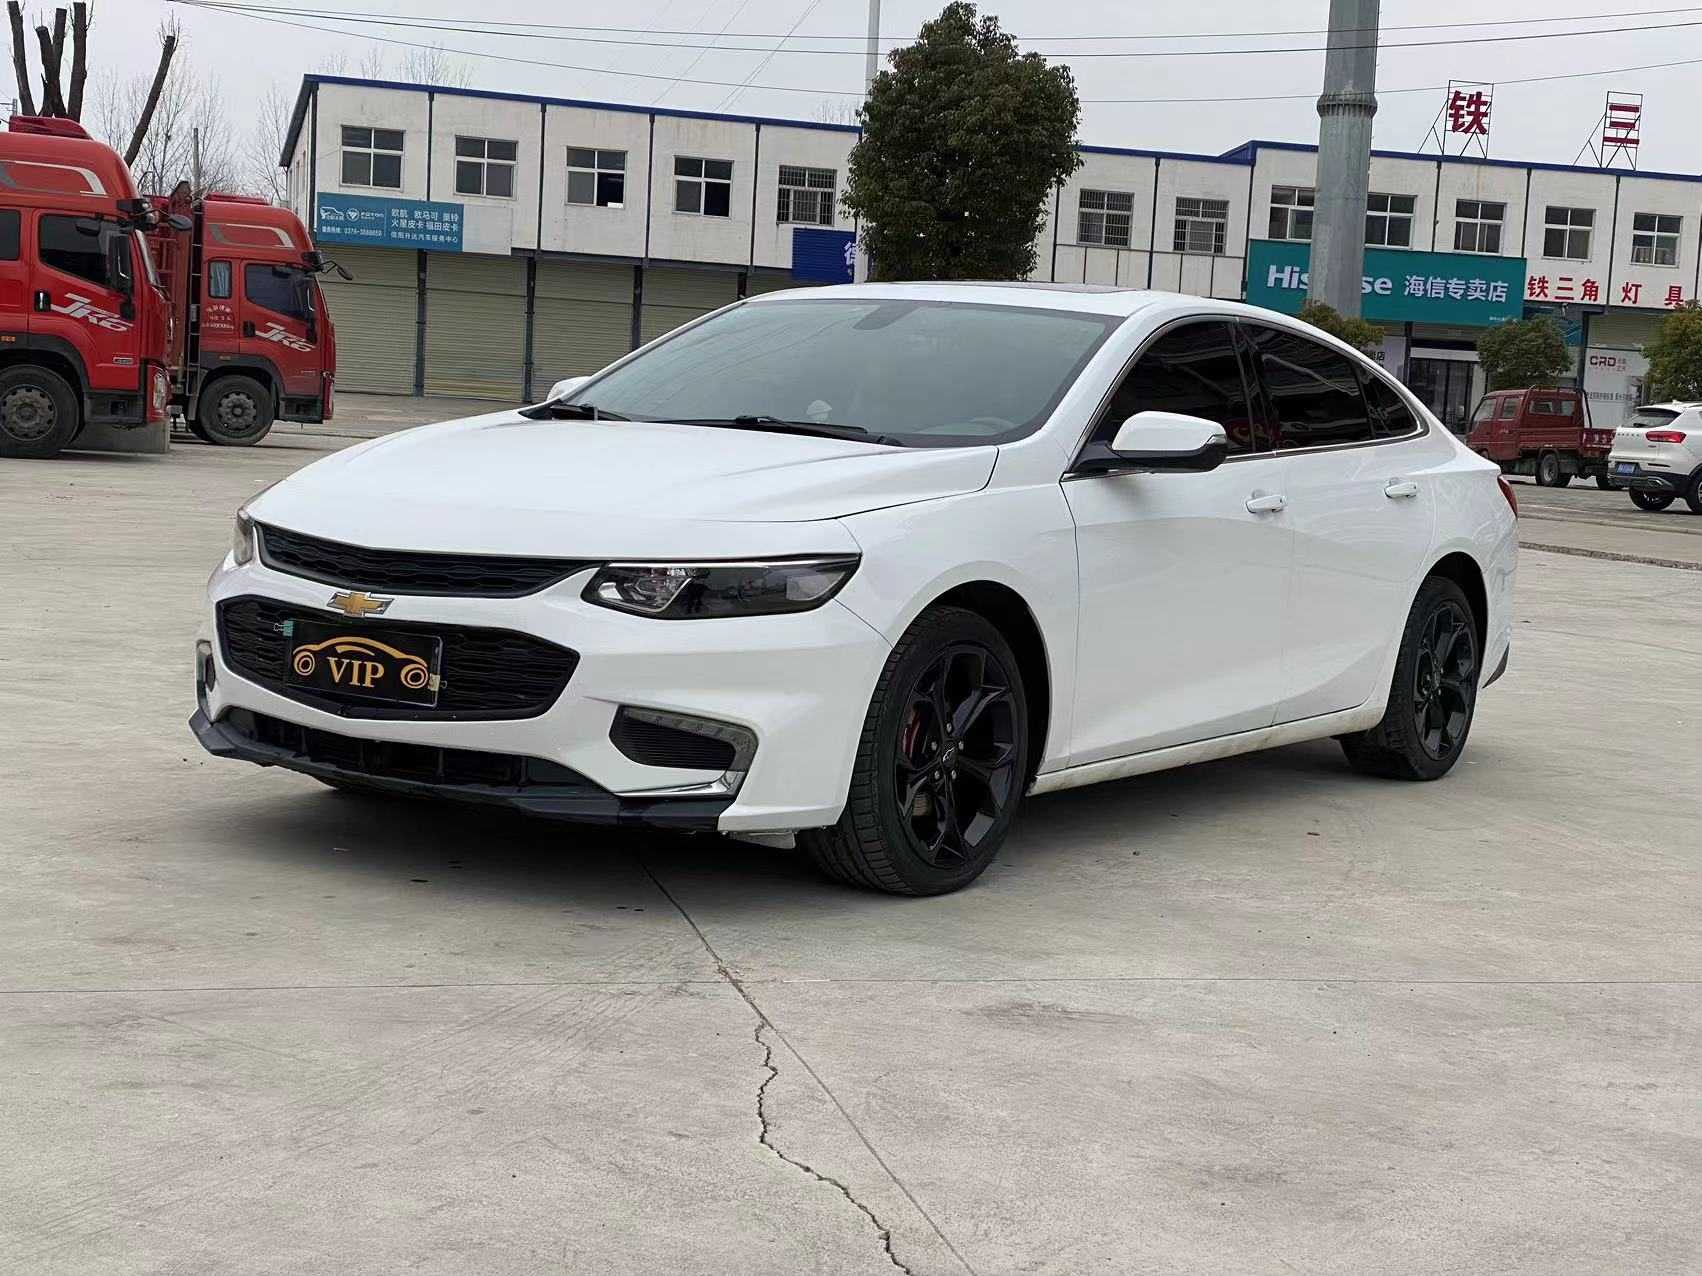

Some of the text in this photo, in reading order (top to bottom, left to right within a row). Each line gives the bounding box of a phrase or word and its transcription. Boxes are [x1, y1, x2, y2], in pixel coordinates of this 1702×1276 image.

[1448, 90, 1641, 145] 铁 三
[1266, 264, 1393, 295] Hisse
[1403, 274, 1509, 303] 海信专卖店
[1589, 355, 1617, 367] CRD
[326, 656, 386, 689] VIP
